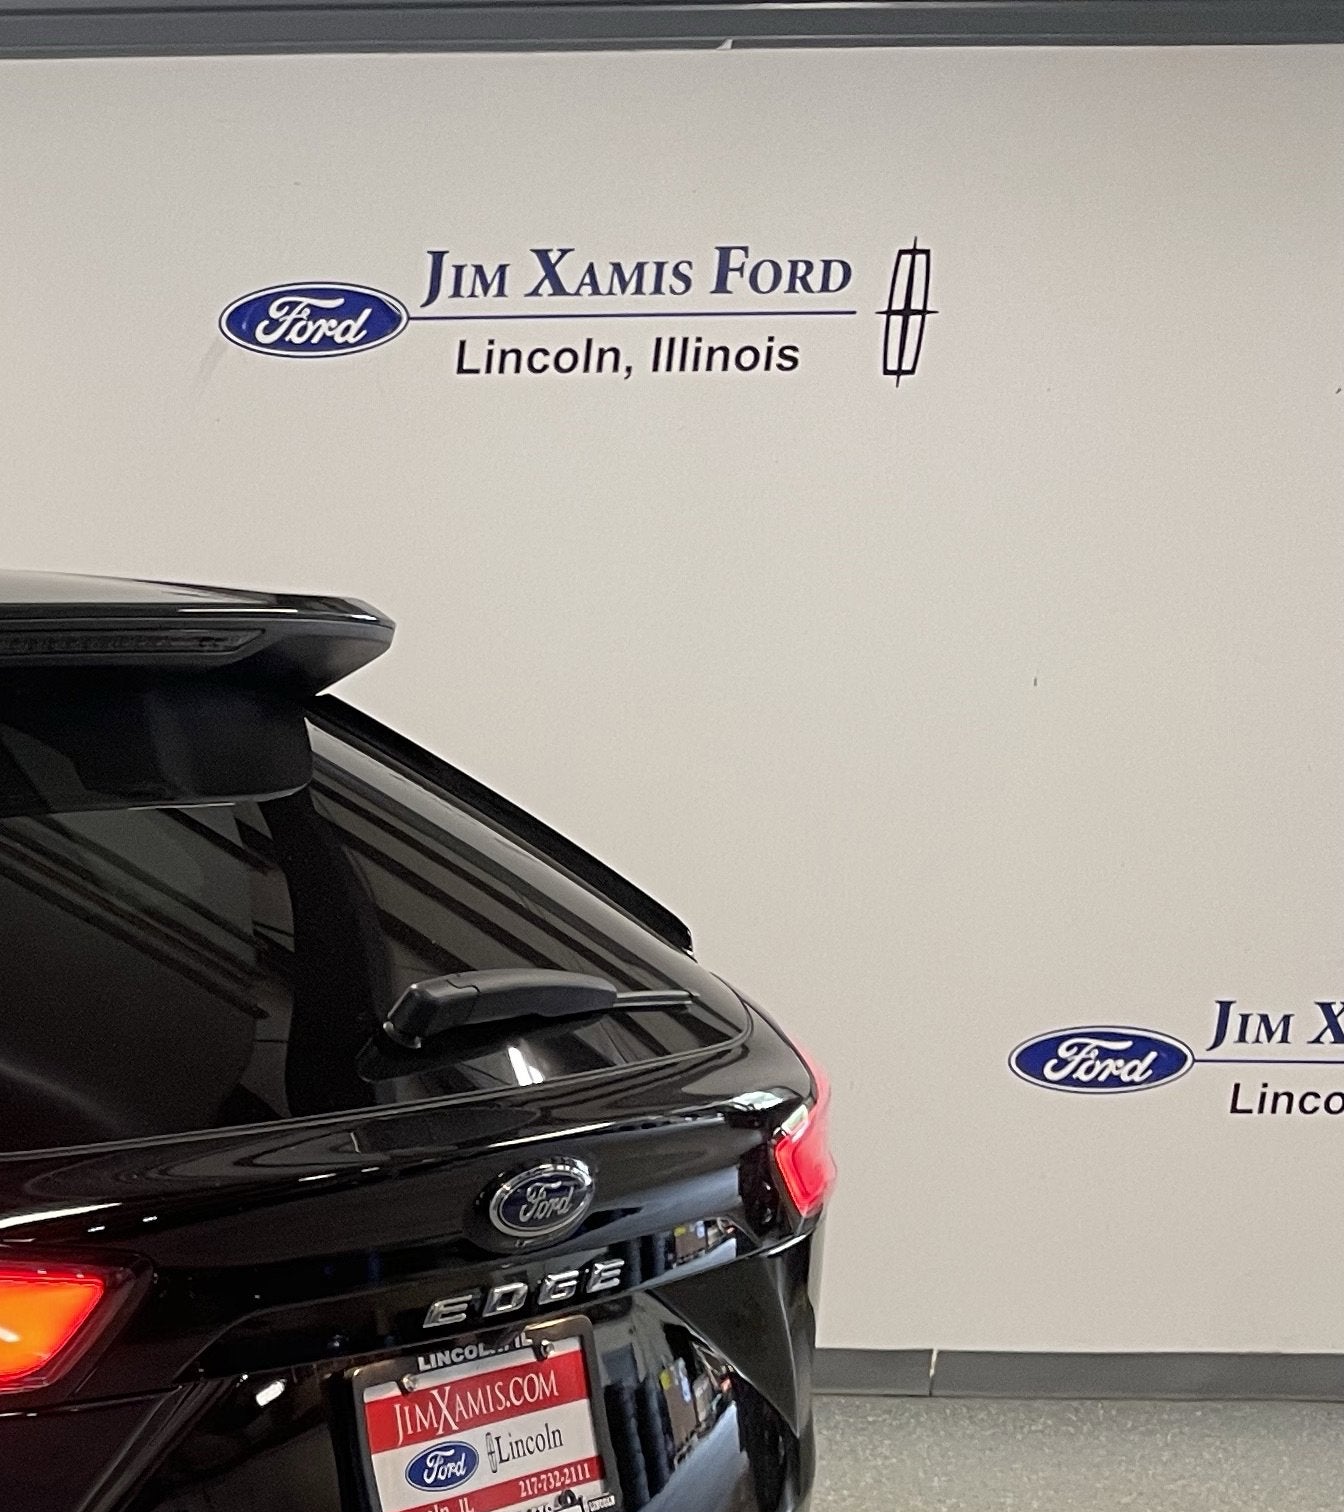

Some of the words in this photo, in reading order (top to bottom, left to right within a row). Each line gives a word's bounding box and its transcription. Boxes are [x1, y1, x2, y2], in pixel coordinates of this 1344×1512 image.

[523, 246, 695, 298] XAMIS
[709, 244, 854, 296] FORD
[254, 296, 369, 346] Ford
[455, 337, 634, 380] Lincoln,
[650, 335, 801, 374] Illinois
[1042, 1037, 1159, 1083] Ford
[519, 1180, 574, 1223] Ford
[422, 1258, 625, 1328] EDGE
[494, 1422, 564, 1464] Lincoln
[423, 1448, 468, 1485] Ford
[517, 1462, 592, 1498] 217-732-2111
